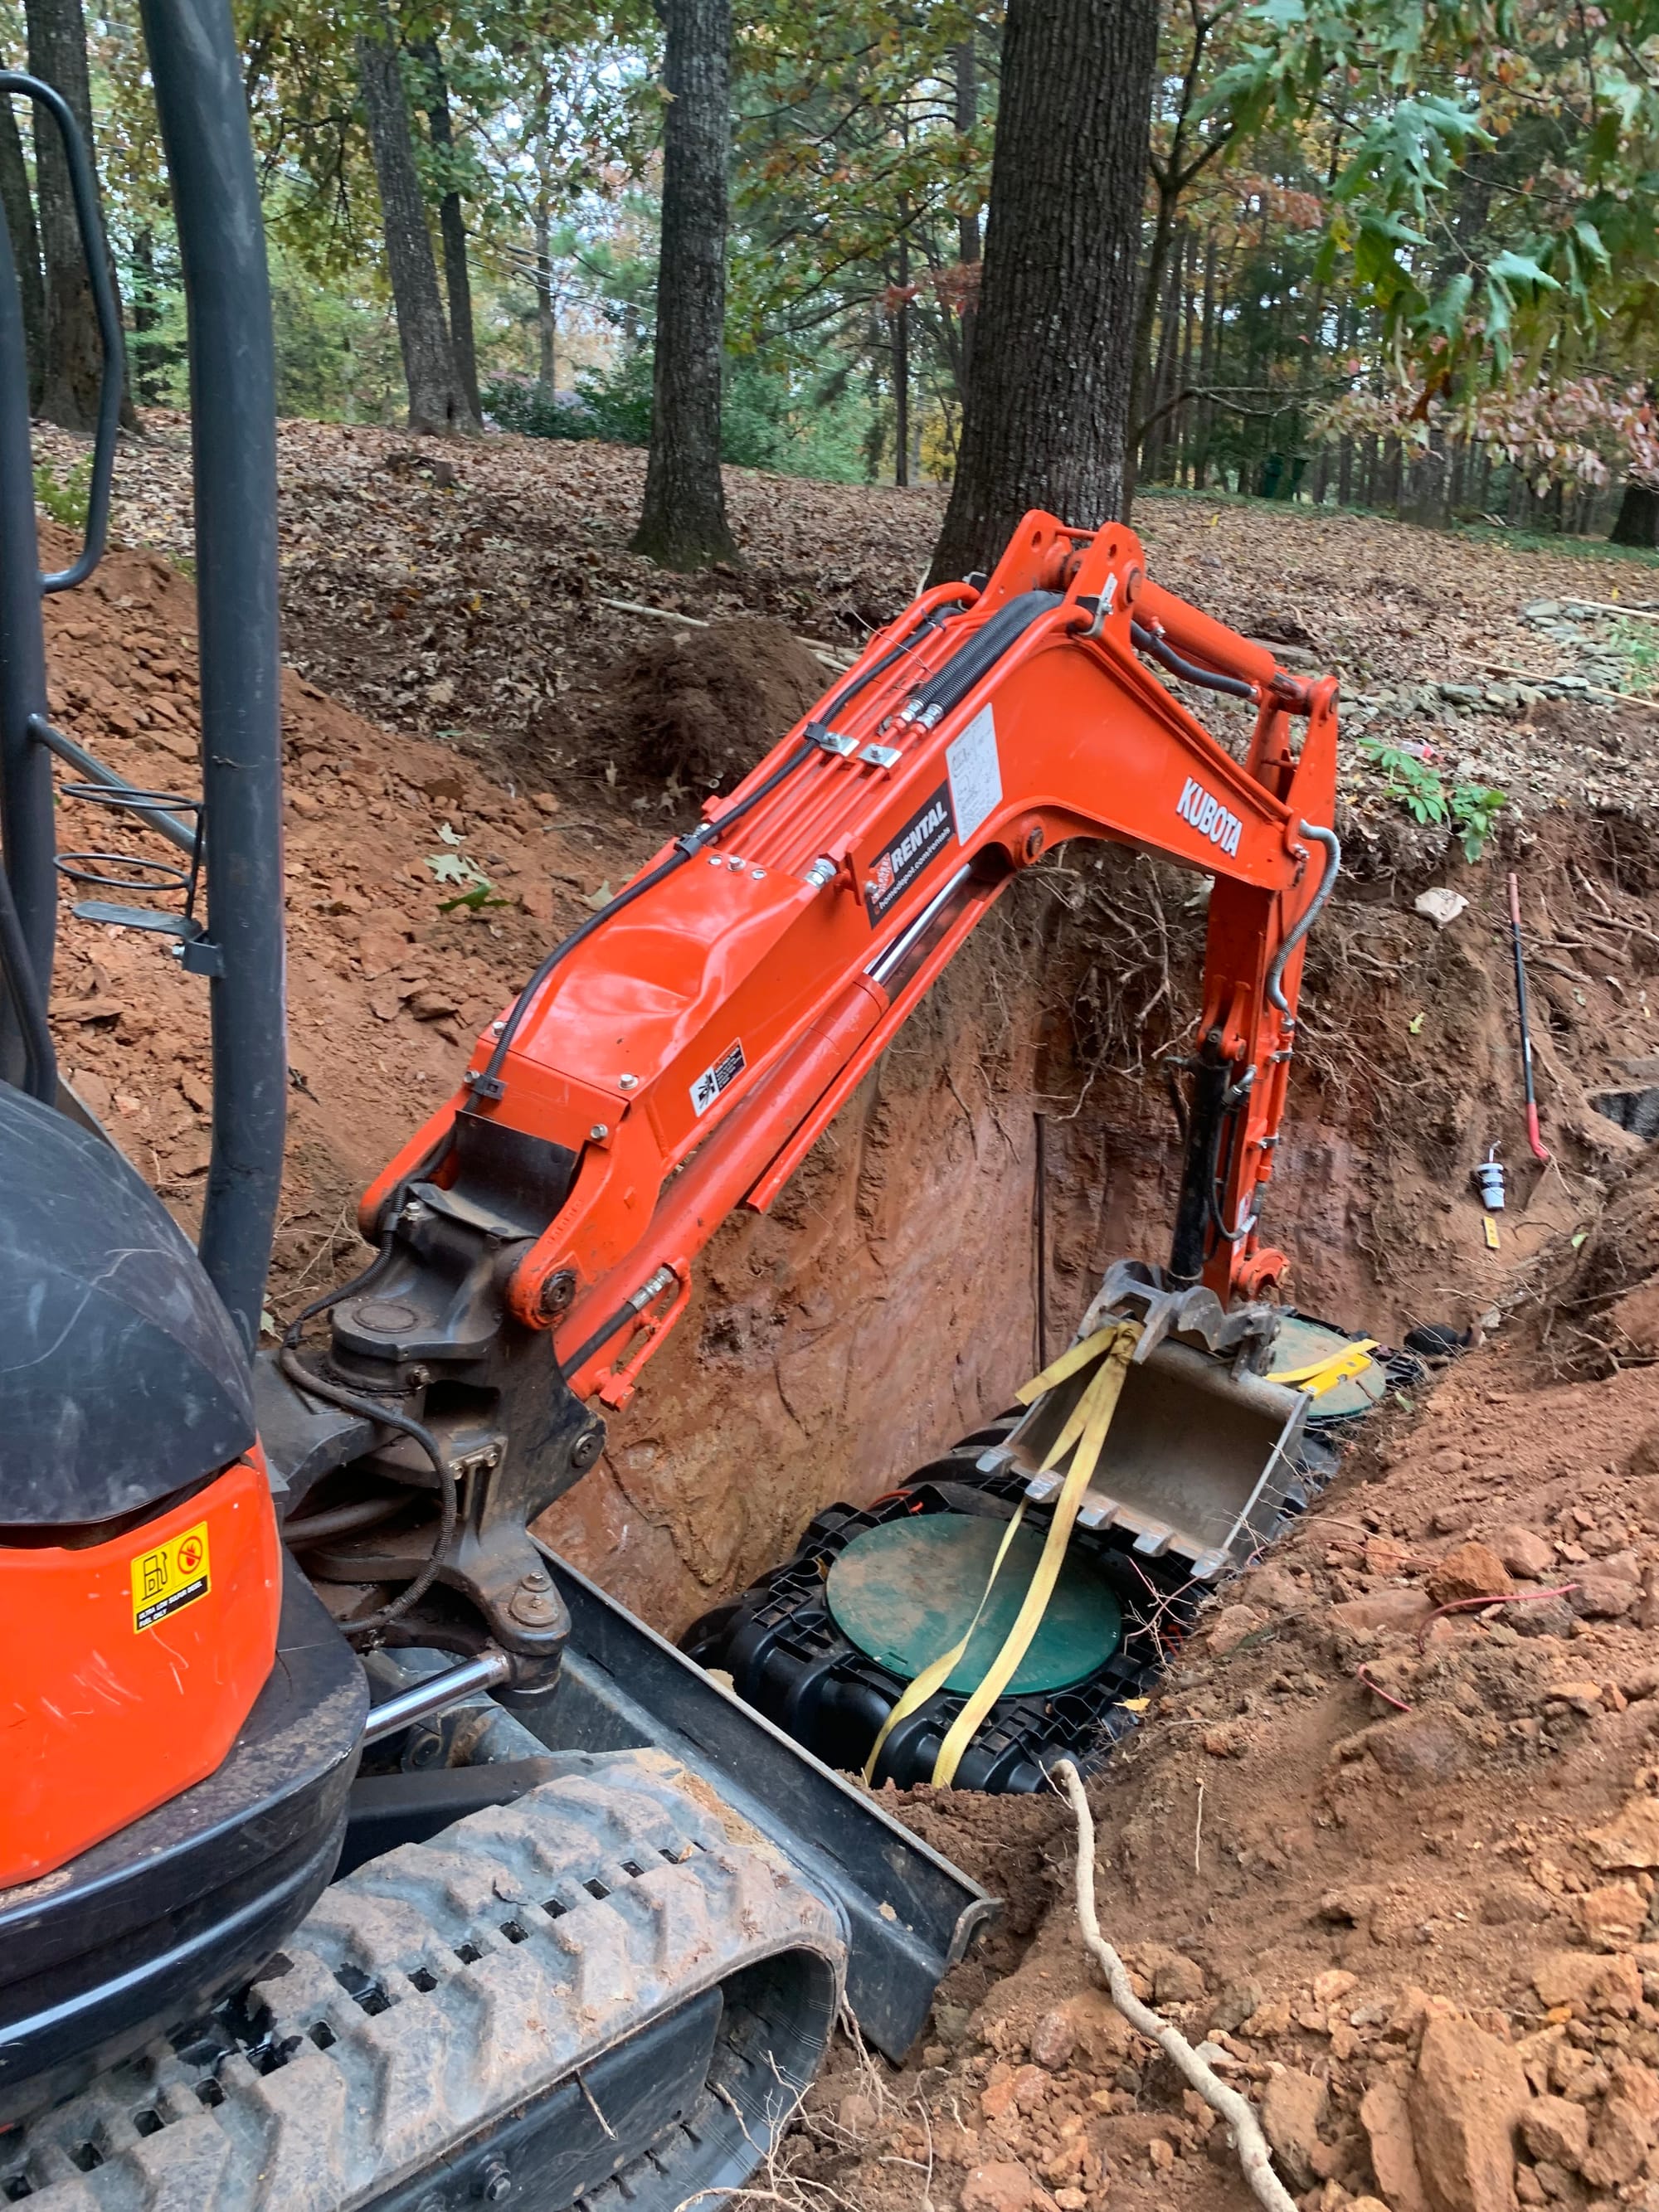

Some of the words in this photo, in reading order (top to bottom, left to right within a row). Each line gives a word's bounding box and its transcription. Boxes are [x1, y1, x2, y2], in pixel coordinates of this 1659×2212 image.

[890, 801, 947, 873] RENTAL
[1176, 775, 1243, 858] KUBOTA
[153, 1608, 168, 1621] ONLY
